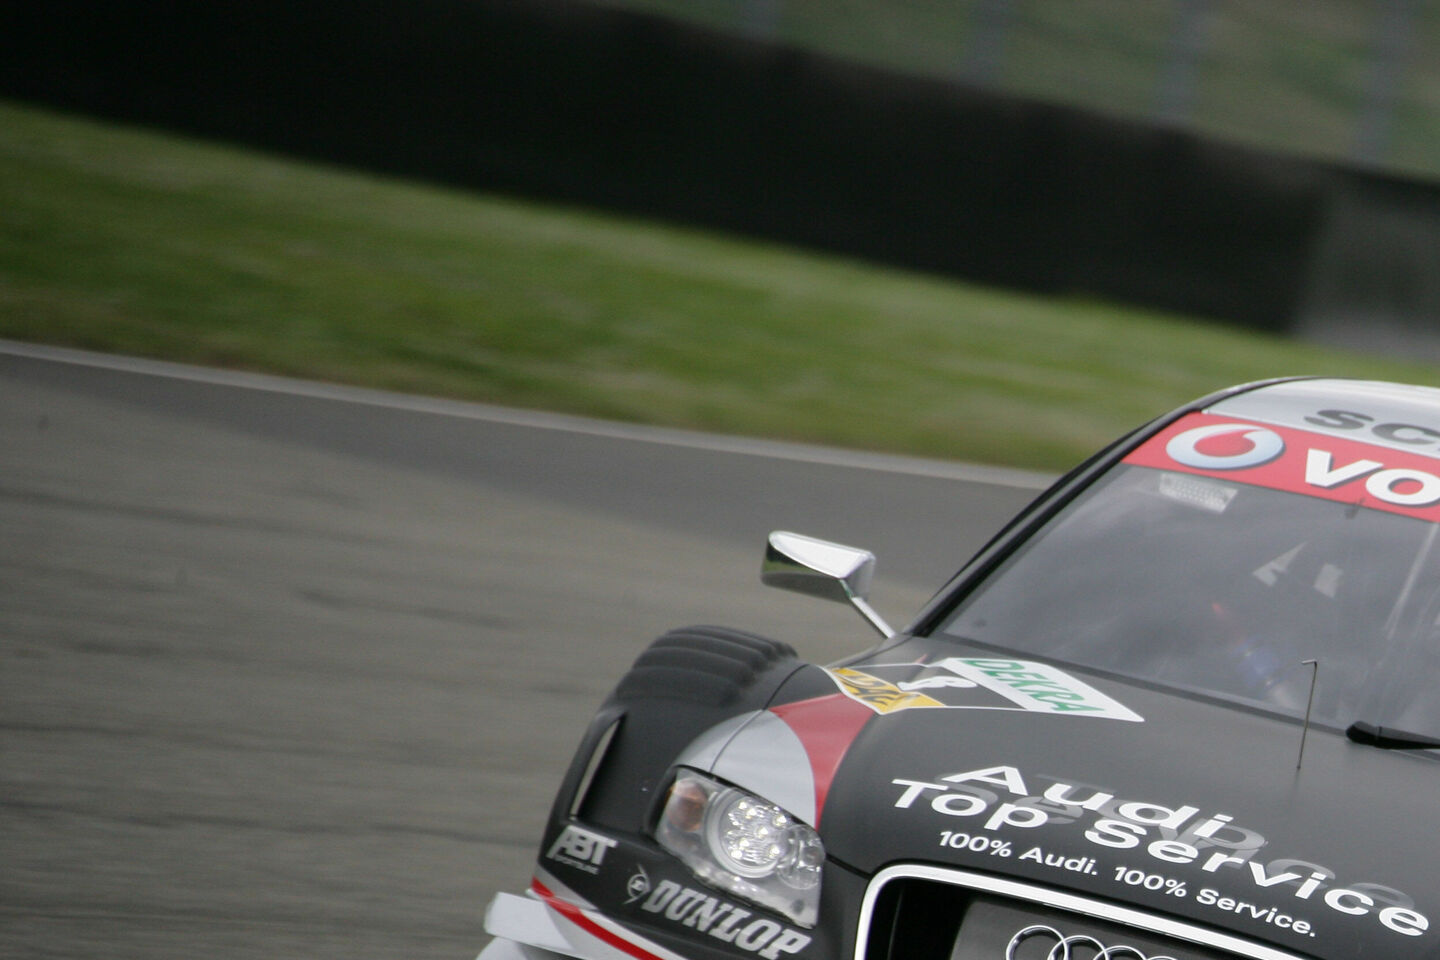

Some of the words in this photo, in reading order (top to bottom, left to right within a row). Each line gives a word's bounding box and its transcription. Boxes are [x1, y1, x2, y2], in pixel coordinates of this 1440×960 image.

[954, 659, 1105, 713] DEKRA
[942, 765, 1233, 838] Audi
[546, 825, 618, 864] ABT
[891, 778, 1049, 831] Top
[1084, 818, 1430, 938] Service
[641, 879, 812, 960] DUNLOP
[938, 830, 1012, 858] 100%
[1018, 845, 1098, 876] Audi.
[1113, 865, 1187, 899] 100%
[1195, 887, 1317, 938] Service.
